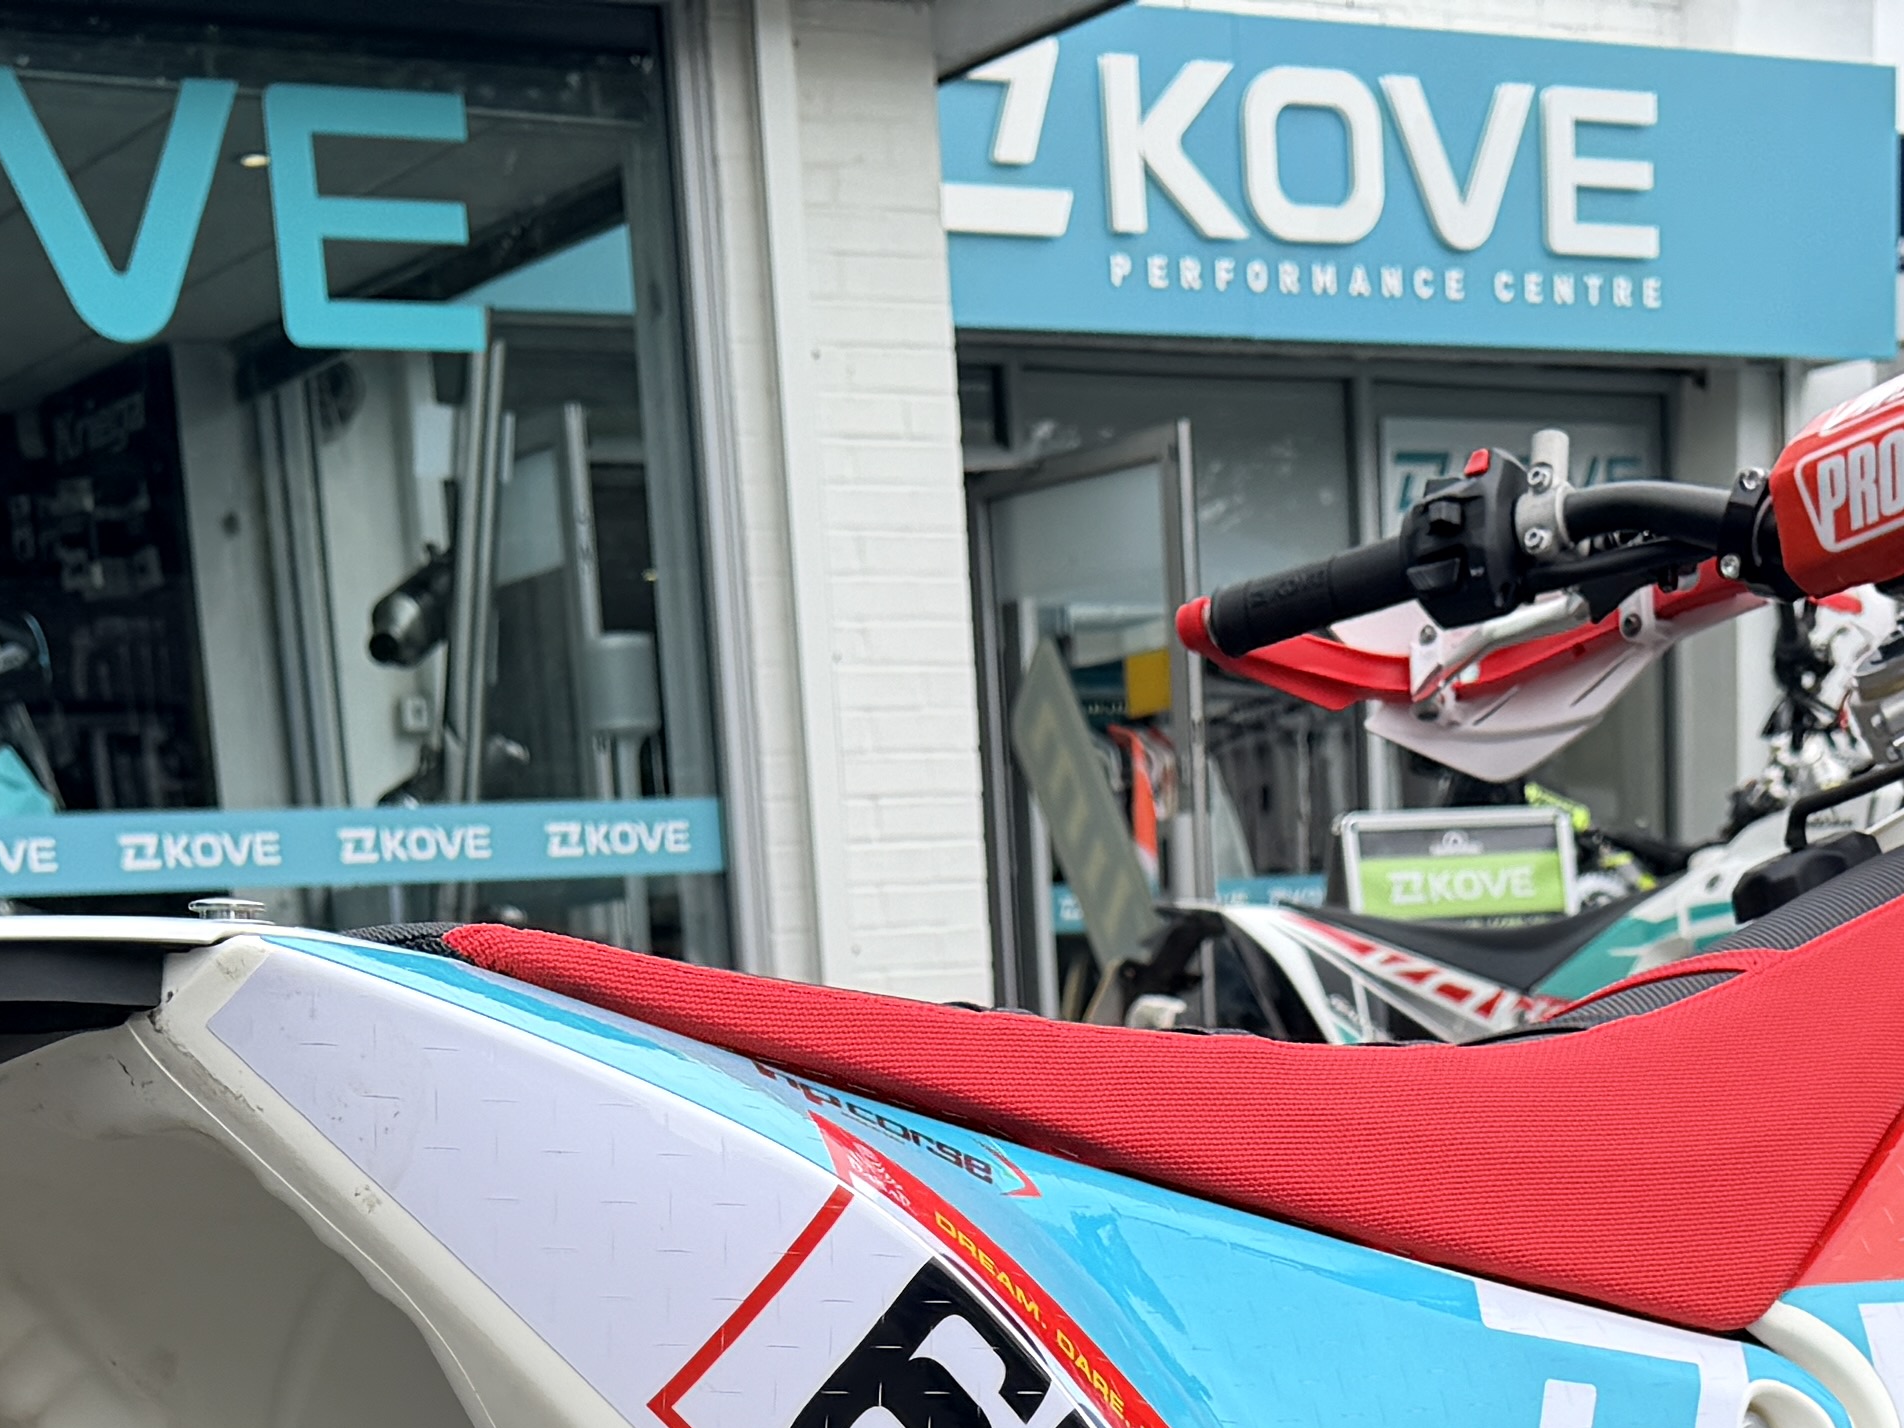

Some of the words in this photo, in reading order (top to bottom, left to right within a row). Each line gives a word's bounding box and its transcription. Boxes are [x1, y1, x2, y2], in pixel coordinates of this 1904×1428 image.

[1098, 52, 1660, 259] KOVE
[1109, 250, 1466, 301] PERFORMANCE
[1493, 269, 1663, 309] CENTRE
[163, 830, 282, 869] KOVE
[380, 824, 493, 862] KOVE
[586, 819, 691, 856] KOVE
[1428, 863, 1536, 903] KOVE
[934, 1209, 1048, 1330] DREAM.
